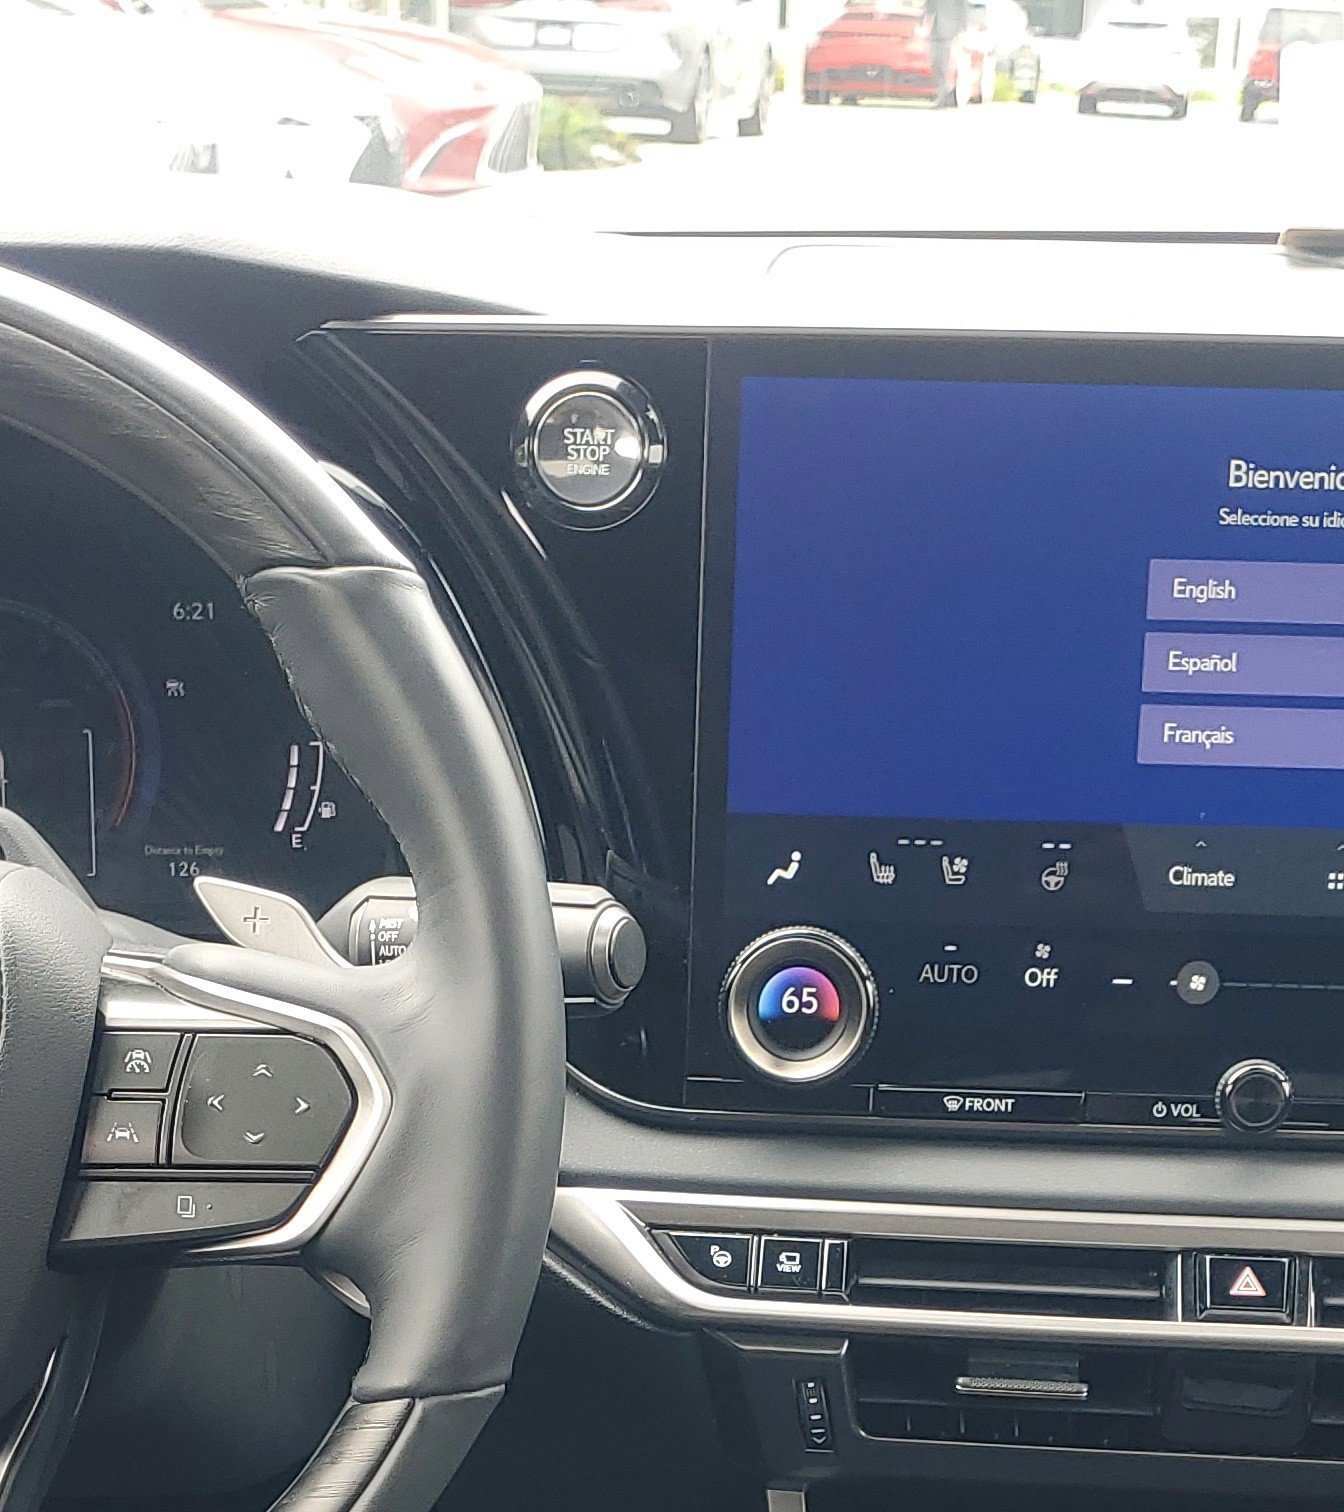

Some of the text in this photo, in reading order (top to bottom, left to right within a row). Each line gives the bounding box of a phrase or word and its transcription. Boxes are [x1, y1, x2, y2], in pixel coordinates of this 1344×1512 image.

[563, 428, 616, 445] START
[566, 445, 611, 461] STOP
[566, 463, 611, 476] ENGINE
[1218, 507, 1299, 528] Seleccione
[1301, 514, 1320, 529] su
[1172, 577, 1237, 604] English
[172, 602, 215, 621] 6:21
[1167, 651, 1238, 676] Español
[1163, 722, 1235, 750] Français
[291, 834, 302, 848] E
[169, 861, 201, 877] 126
[1168, 865, 1236, 887] Climate
[377, 931, 399, 942] OFF
[379, 945, 407, 956] AUTO
[919, 963, 979, 985] AUTO
[1024, 966, 1059, 988] Off
[781, 986, 819, 1015] 65
[964, 1097, 1015, 1113] FRONT
[1170, 1103, 1202, 1118] VOL
[776, 1264, 802, 1273] VIEW
